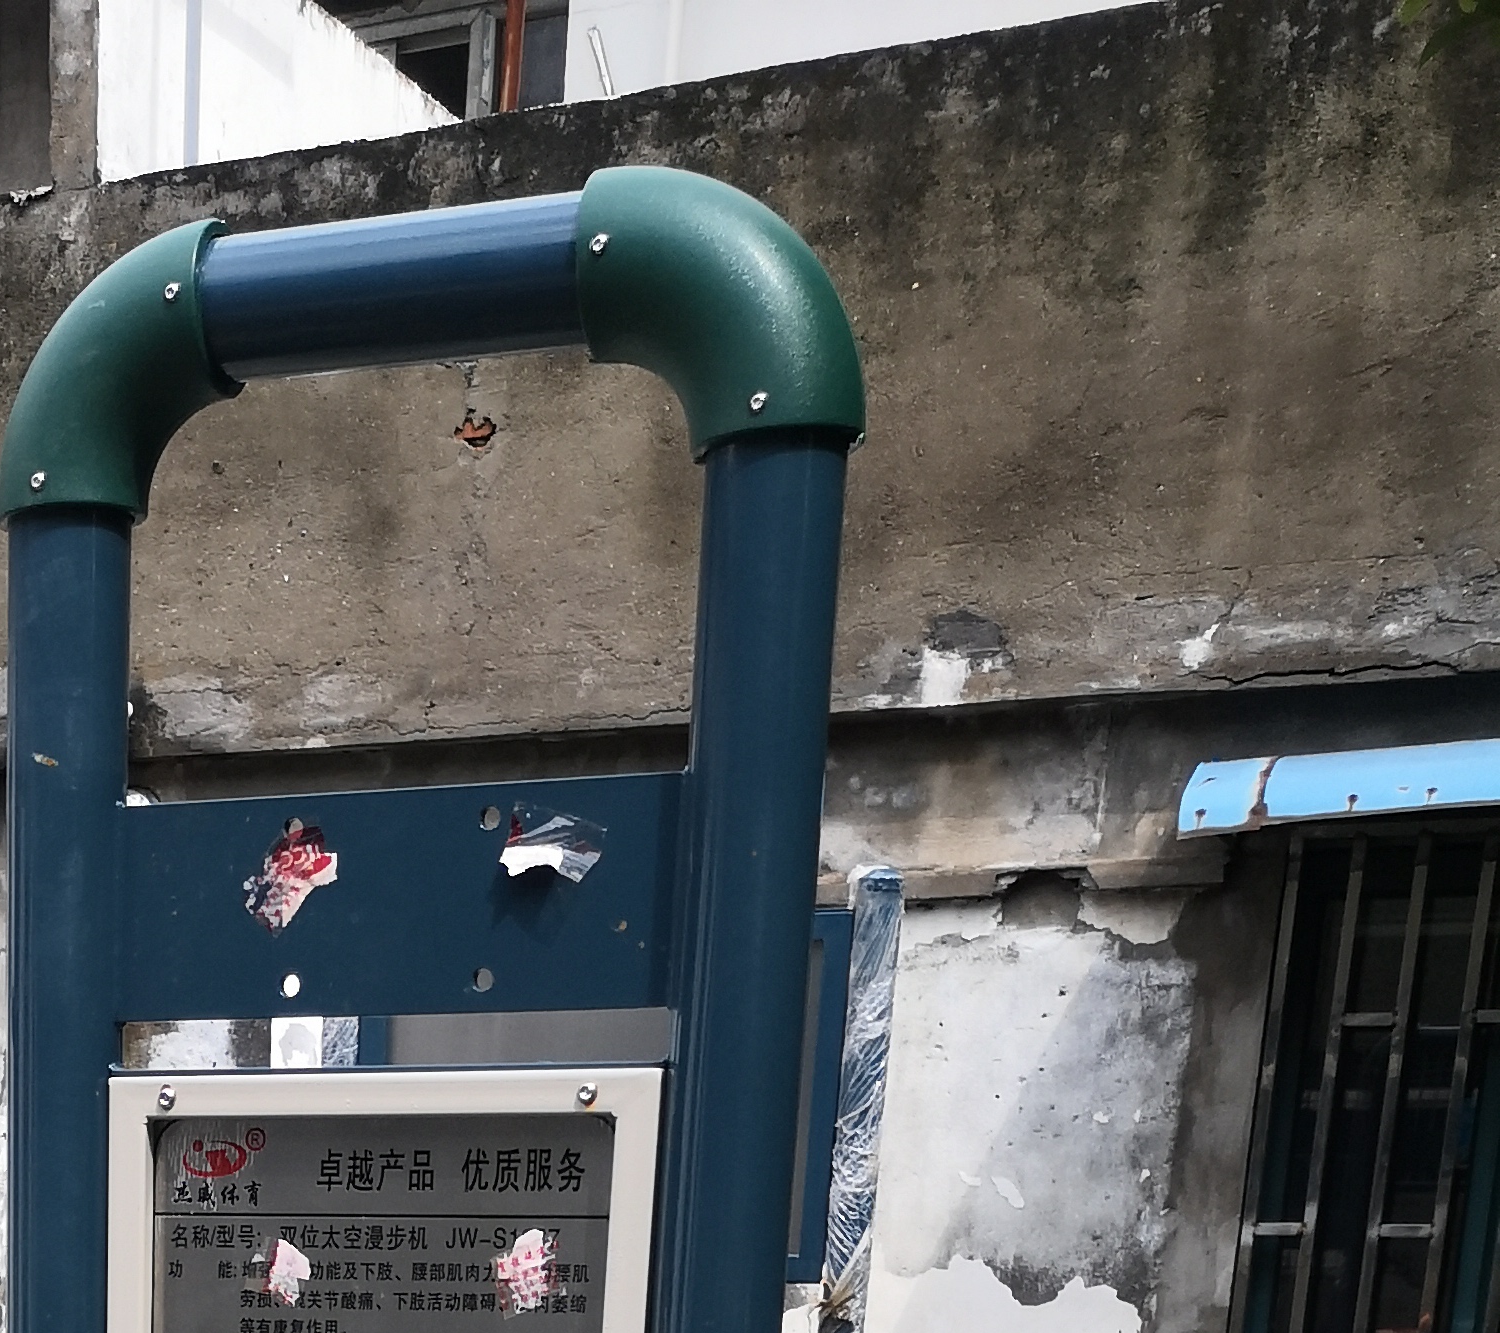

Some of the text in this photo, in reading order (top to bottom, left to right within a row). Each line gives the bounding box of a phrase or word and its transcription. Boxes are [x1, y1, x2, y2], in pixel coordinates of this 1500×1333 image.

[316, 1148, 586, 1193] 卓越产品 优质服务
[445, 1226, 561, 1251] JW-S17
